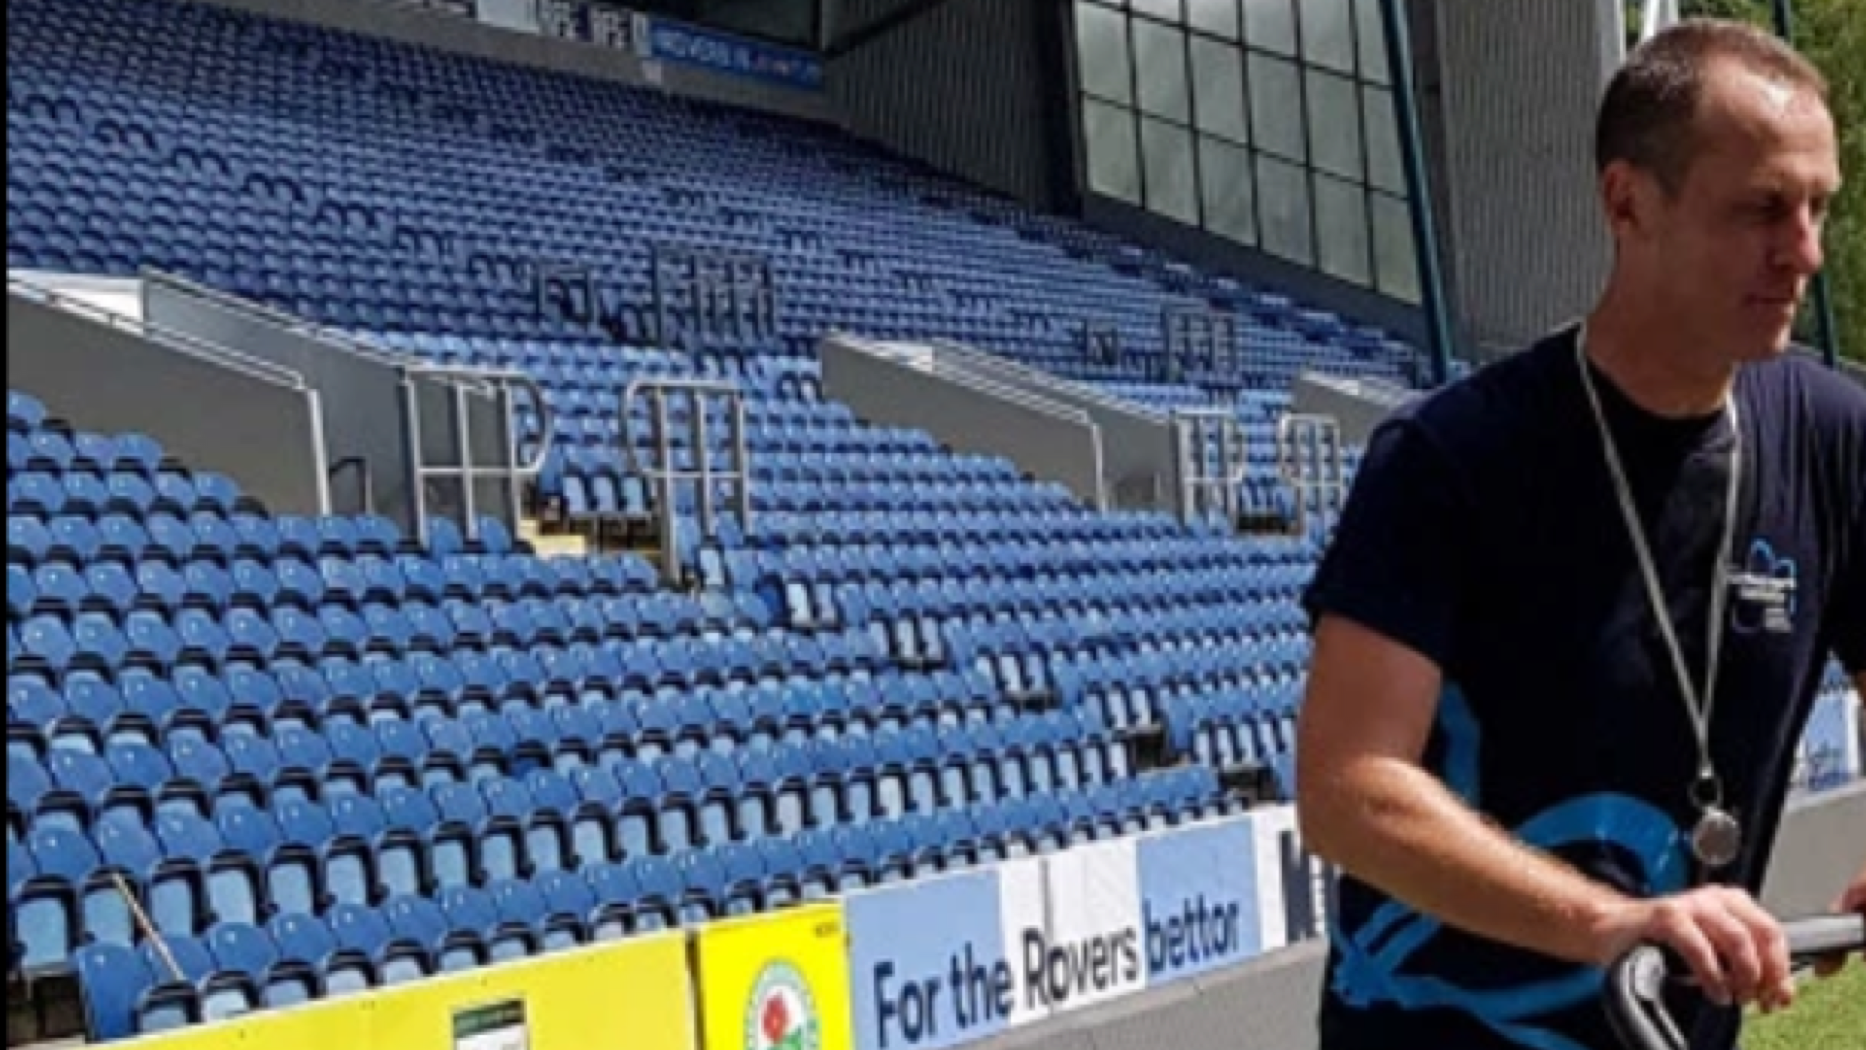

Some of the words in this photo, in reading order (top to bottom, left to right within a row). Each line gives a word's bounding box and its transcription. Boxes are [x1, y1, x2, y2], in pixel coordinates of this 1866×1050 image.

[872, 960, 942, 1050] For
[948, 942, 1016, 1029] the
[1022, 925, 1138, 1007] Rovers
[1144, 895, 1242, 974] bettor
